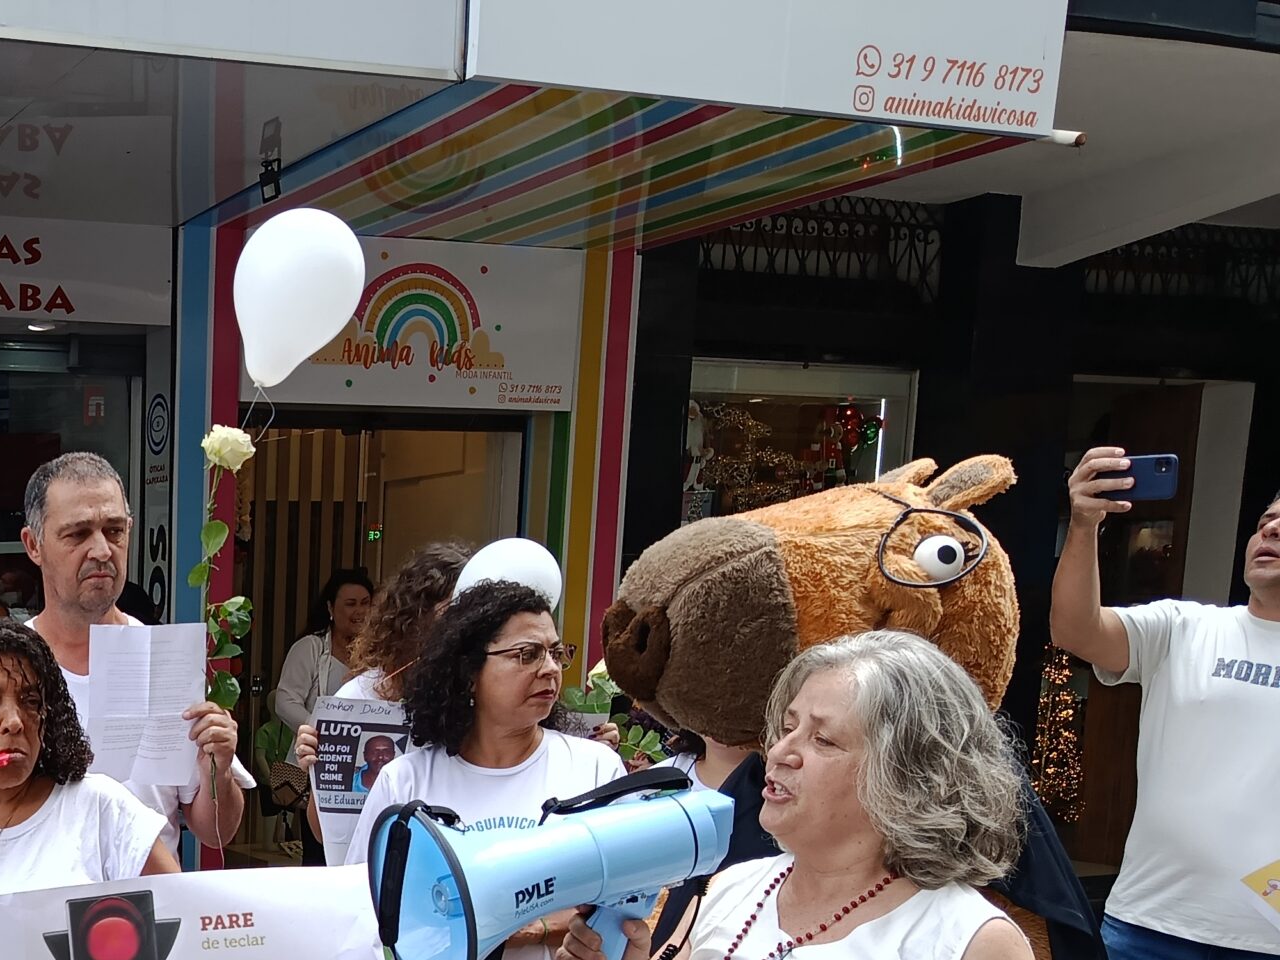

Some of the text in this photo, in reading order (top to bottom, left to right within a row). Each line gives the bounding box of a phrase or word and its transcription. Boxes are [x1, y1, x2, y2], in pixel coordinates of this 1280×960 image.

[887, 52, 1044, 94] 31 9 7116 8173
[883, 92, 1038, 128] animakidsvicosa
[341, 338, 415, 370] Anima
[455, 370, 513, 381] MODA INFANTIL
[320, 722, 362, 737] LUTO
[318, 742, 350, 753] NÃO FOI
[318, 754, 353, 763] CIDENTE
[325, 763, 338, 772] FOI
[319, 772, 343, 781] CRIME
[334, 795, 366, 806] Eduard
[514, 877, 555, 909] PYLE
[200, 912, 254, 932] PARE
[201, 934, 266, 950] de teclar
